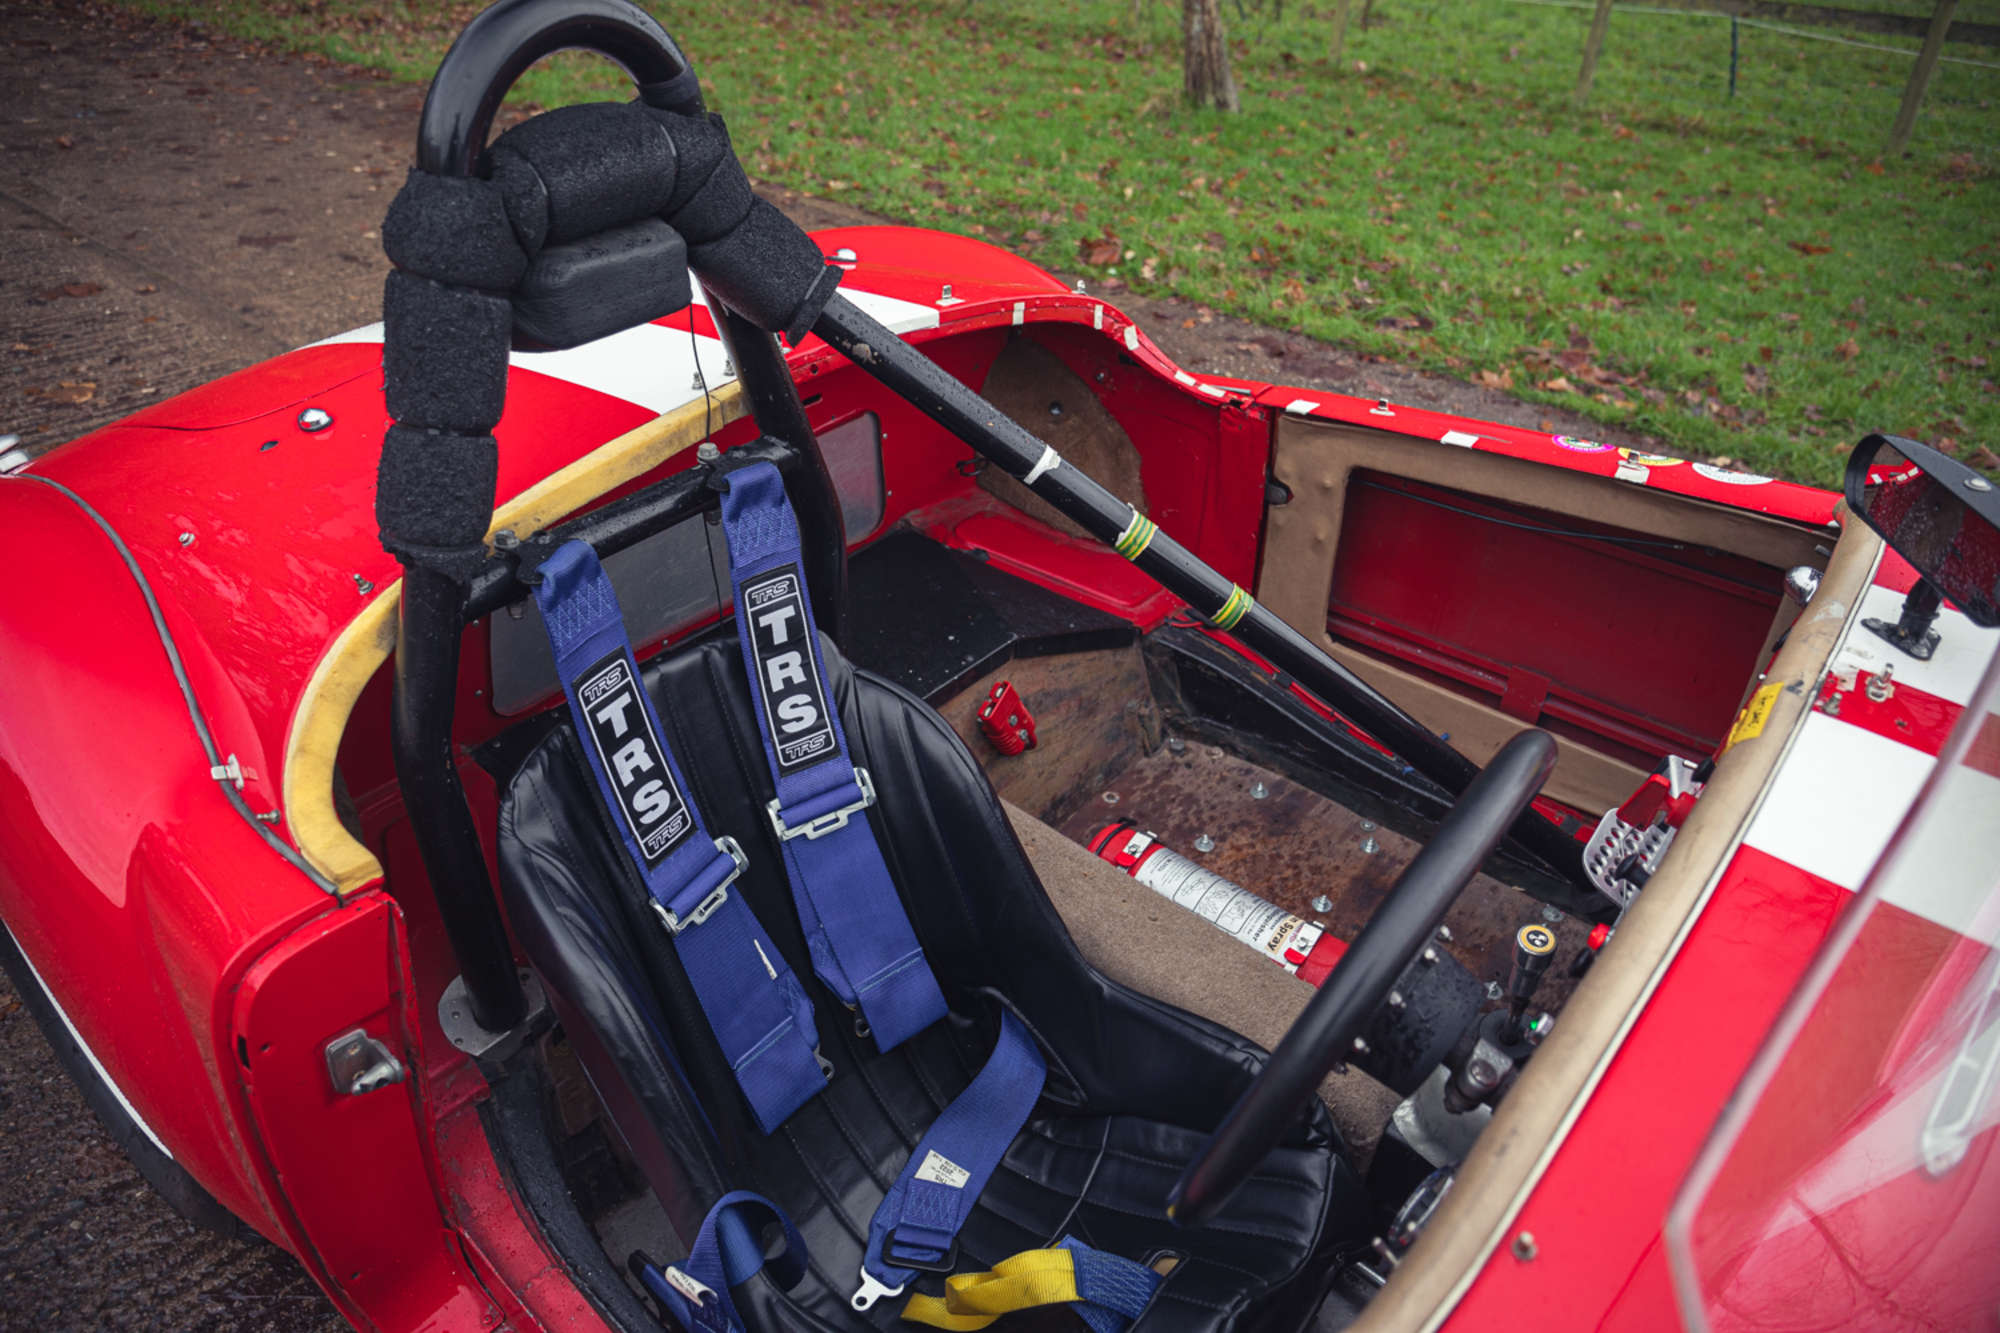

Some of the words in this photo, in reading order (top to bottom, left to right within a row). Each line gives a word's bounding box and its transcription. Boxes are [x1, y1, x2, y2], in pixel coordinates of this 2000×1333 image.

[751, 580, 789, 604] TRS
[584, 667, 622, 701] TRS
[759, 605, 818, 733] TRS
[596, 691, 671, 824] TRS
[785, 734, 826, 760] TRS
[647, 815, 683, 850] TRS
[1267, 922, 1294, 951] Spray
